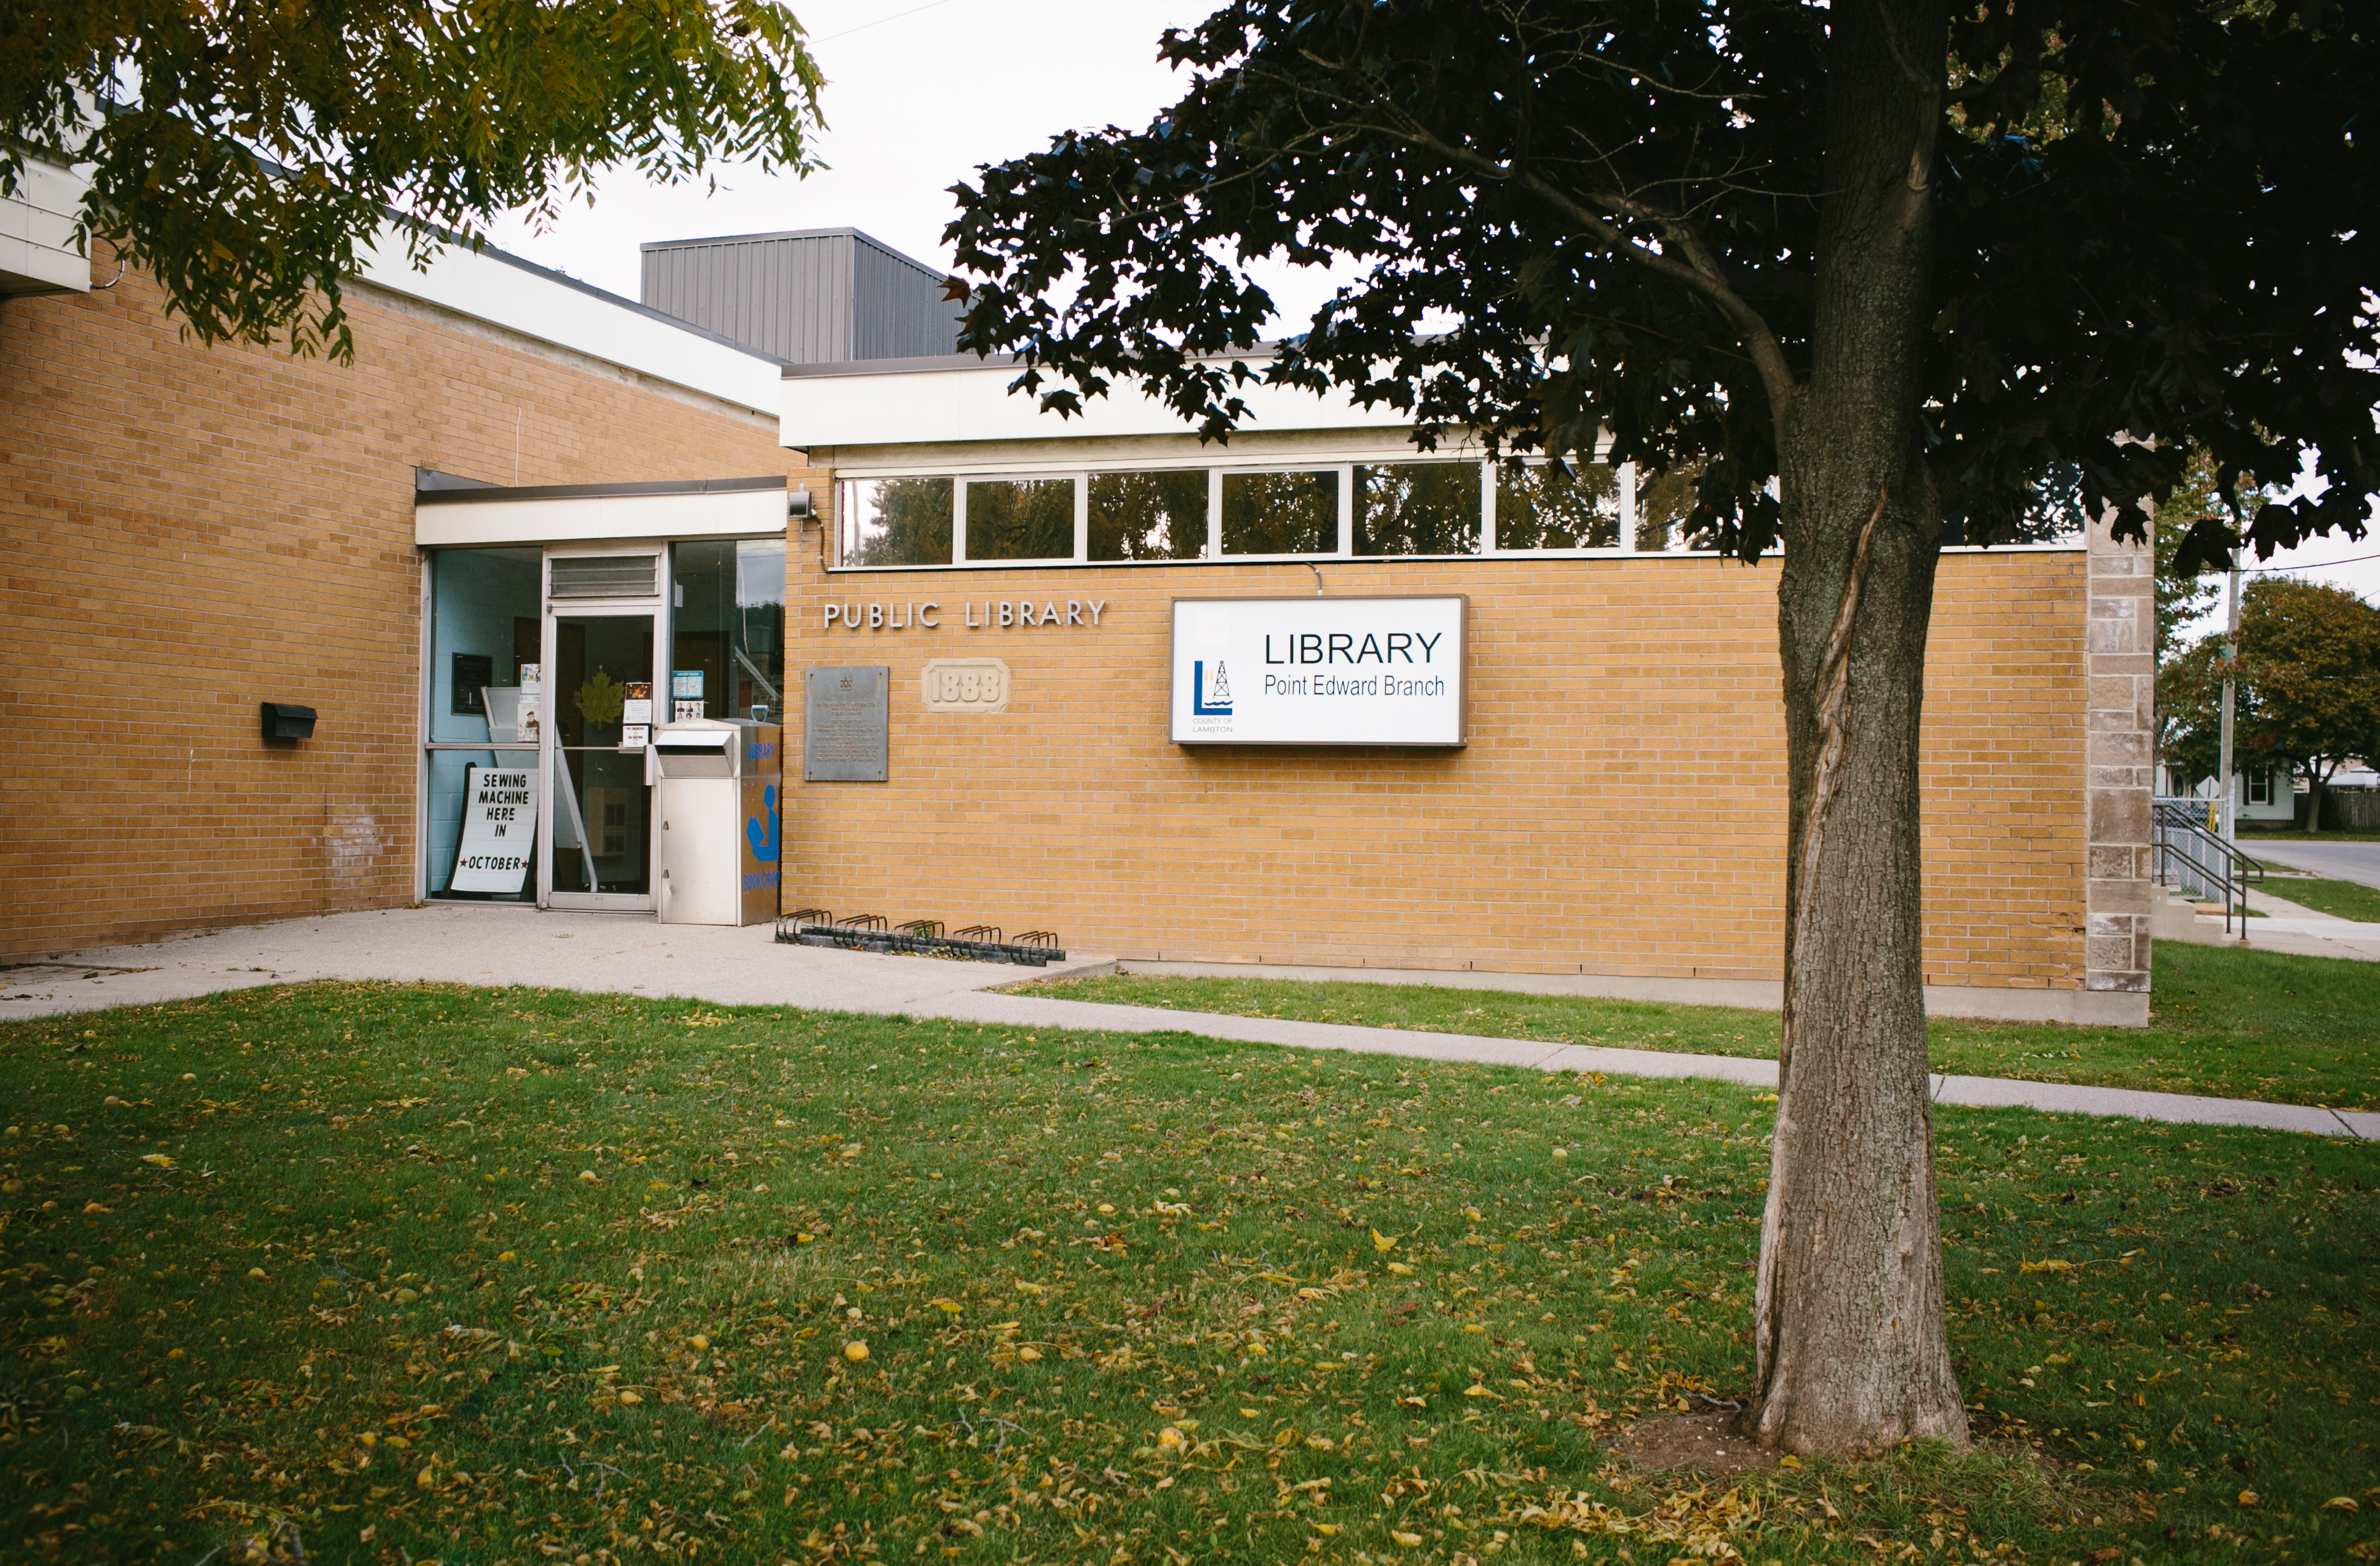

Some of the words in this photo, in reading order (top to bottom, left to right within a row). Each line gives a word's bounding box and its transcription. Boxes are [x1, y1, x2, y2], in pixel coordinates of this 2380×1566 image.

[824, 602, 939, 628] PUBLIC
[965, 600, 1105, 627] LIBRARY
[1265, 632, 1442, 664] LIBRARY
[931, 670, 1000, 702] 1888
[1265, 674, 1307, 695] Point
[1313, 674, 1377, 696] Edward
[1384, 674, 1444, 696] Branch
[748, 743, 775, 759] LIBRARY
[483, 773, 527, 788] SEWING
[478, 791, 529, 805] MACHINE
[486, 807, 515, 821] HERE
[494, 824, 507, 837] IN
[468, 856, 520, 870] OCTOBER
[744, 873, 762, 891] BOOK
[763, 871, 780, 888] DROP
